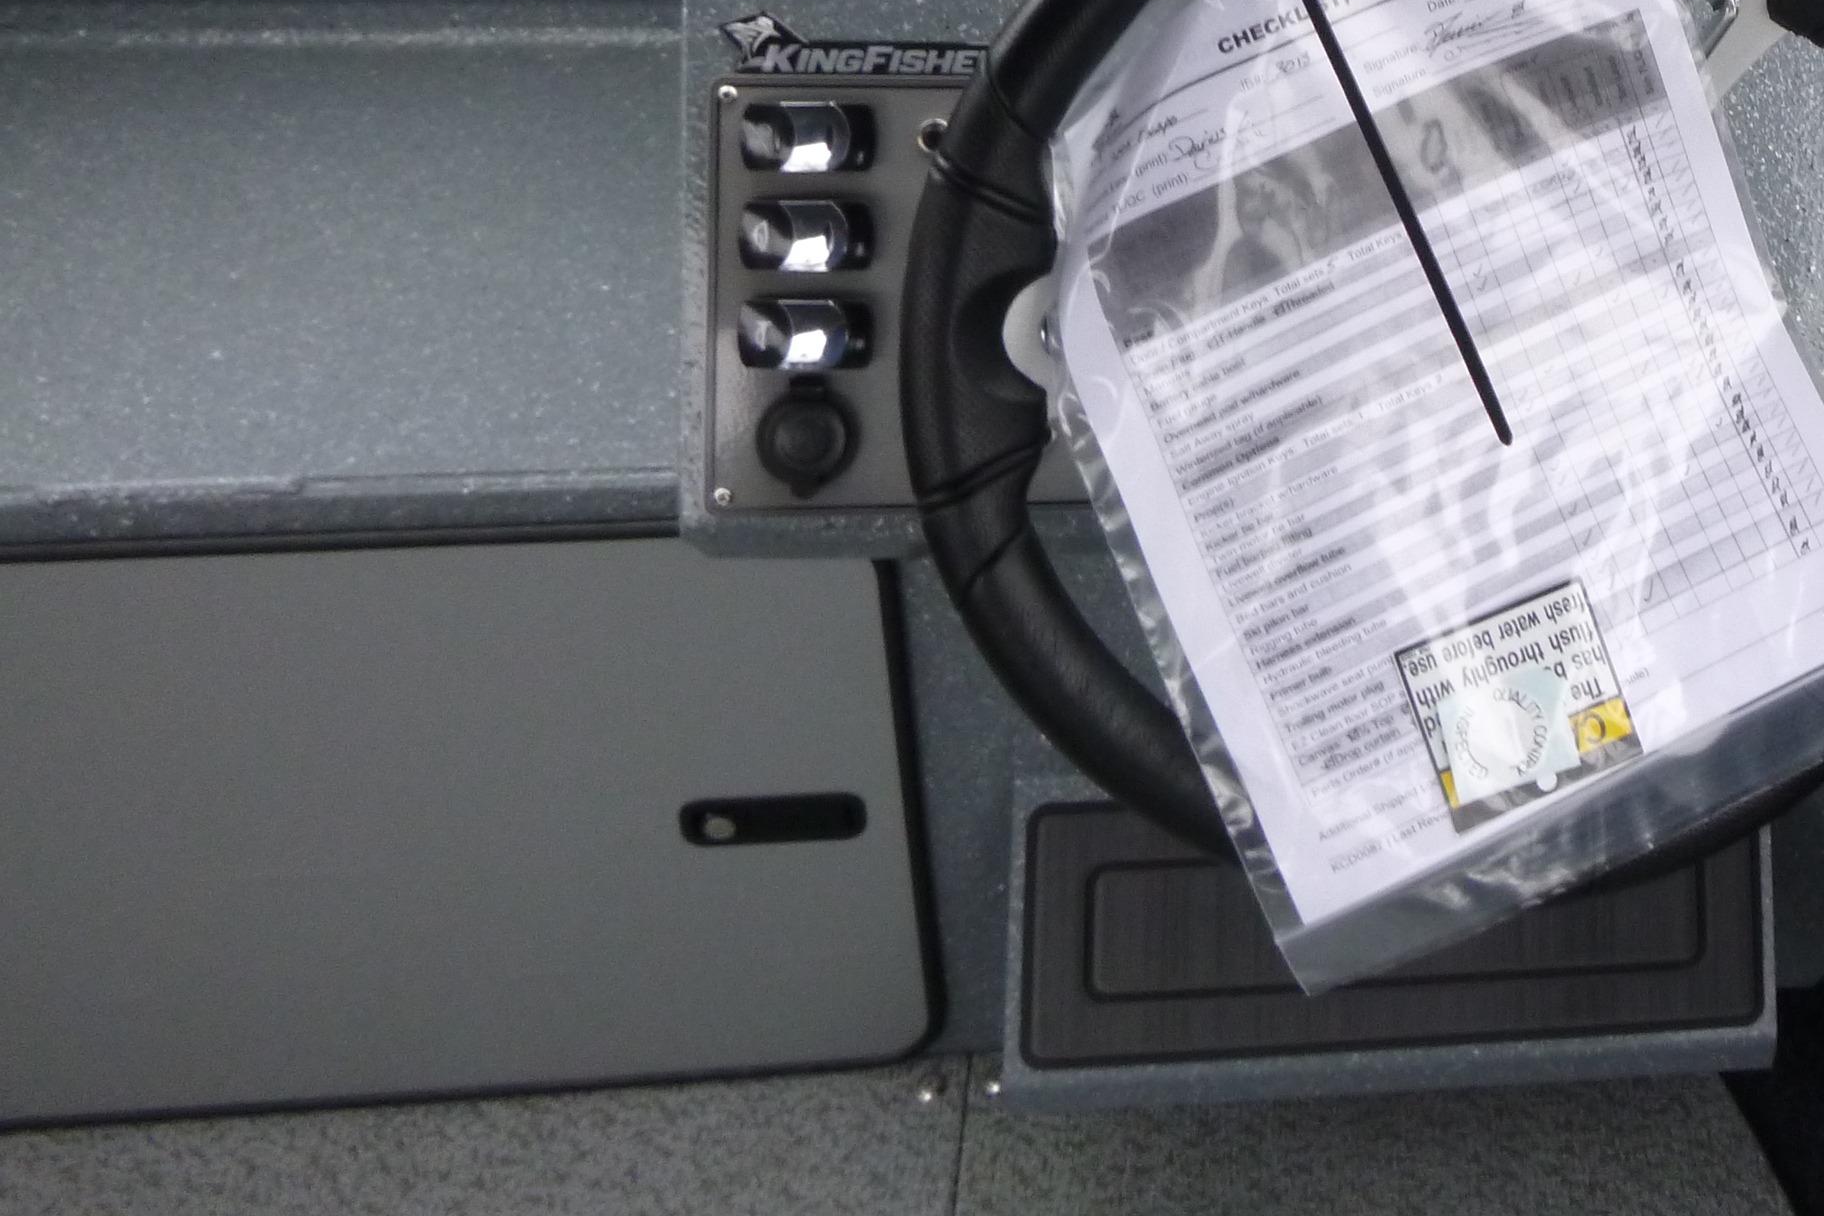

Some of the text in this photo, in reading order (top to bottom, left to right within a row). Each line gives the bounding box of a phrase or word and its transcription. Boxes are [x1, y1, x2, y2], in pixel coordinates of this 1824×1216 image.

[758, 45, 988, 75] KINGFISHE
[1544, 591, 1586, 624] fresh
[1499, 609, 1541, 641] water
[1548, 621, 1594, 653] flush
[1442, 625, 1494, 661] before
[1570, 644, 1605, 673] has
[1416, 680, 1455, 707] with
[1571, 676, 1604, 701] The
